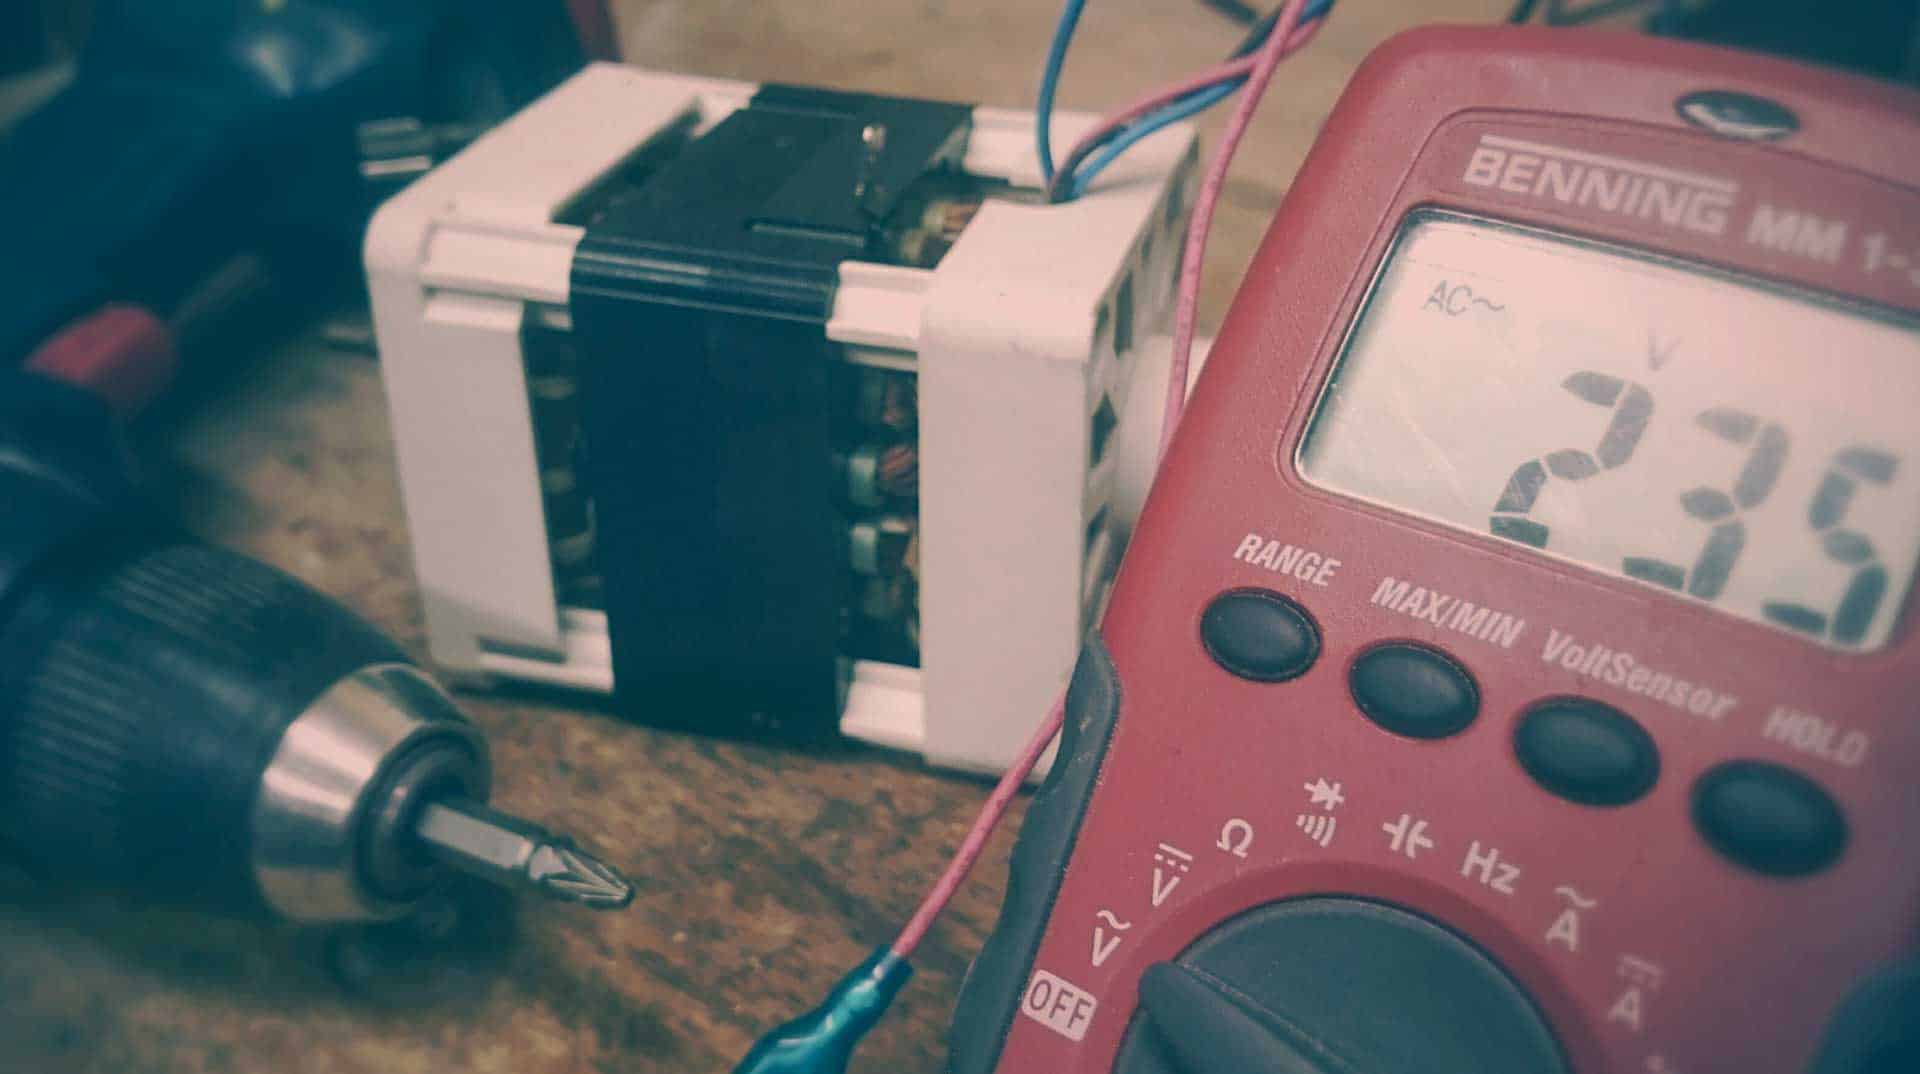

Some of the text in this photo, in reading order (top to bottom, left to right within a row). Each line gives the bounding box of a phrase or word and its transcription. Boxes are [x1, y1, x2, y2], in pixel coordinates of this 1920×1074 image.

[1463, 136, 1739, 234] BENNING
[1745, 205, 1847, 264] MM
[1648, 328, 1682, 371] V
[1490, 371, 1900, 645] 235
[1234, 533, 1342, 586] RANGE
[1370, 576, 1526, 648] MAX/MIN
[1542, 629, 1739, 720] VoltSensor
[1763, 706, 1869, 767] HOLD
[1461, 841, 1520, 894] Hz
[1029, 978, 1092, 1030] OFF
